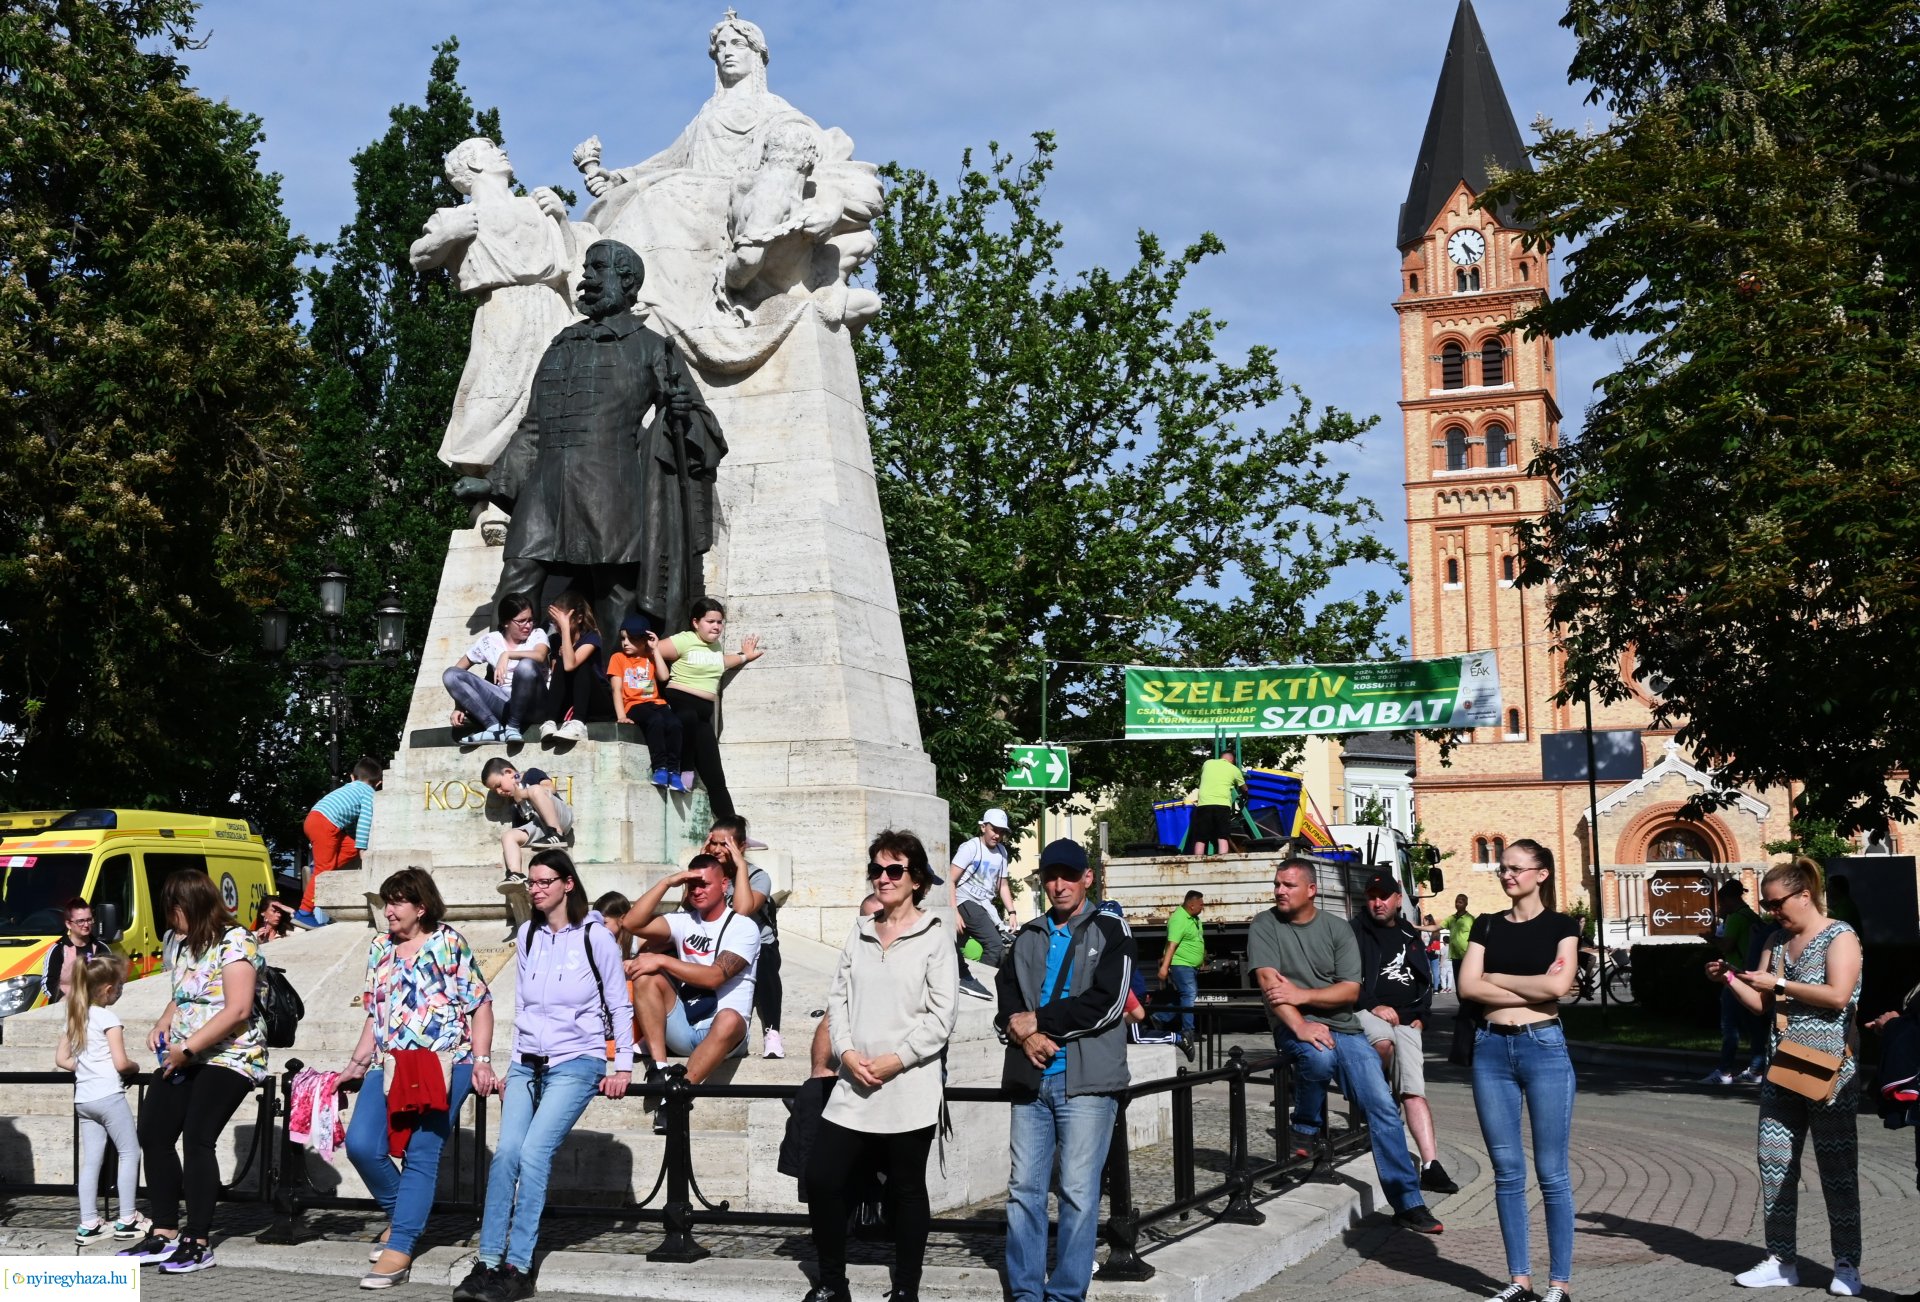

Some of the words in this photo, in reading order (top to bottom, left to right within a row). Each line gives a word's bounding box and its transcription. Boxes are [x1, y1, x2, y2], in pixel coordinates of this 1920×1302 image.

[1139, 672, 1346, 703] SZELEKTÍV
[1353, 681, 1397, 690] KOSSUTH
[1147, 716, 1155, 724] A
[1260, 698, 1452, 730] SZOMBAT
[424, 775, 574, 811] KOSH
[686, 934, 713, 952] NIKE
